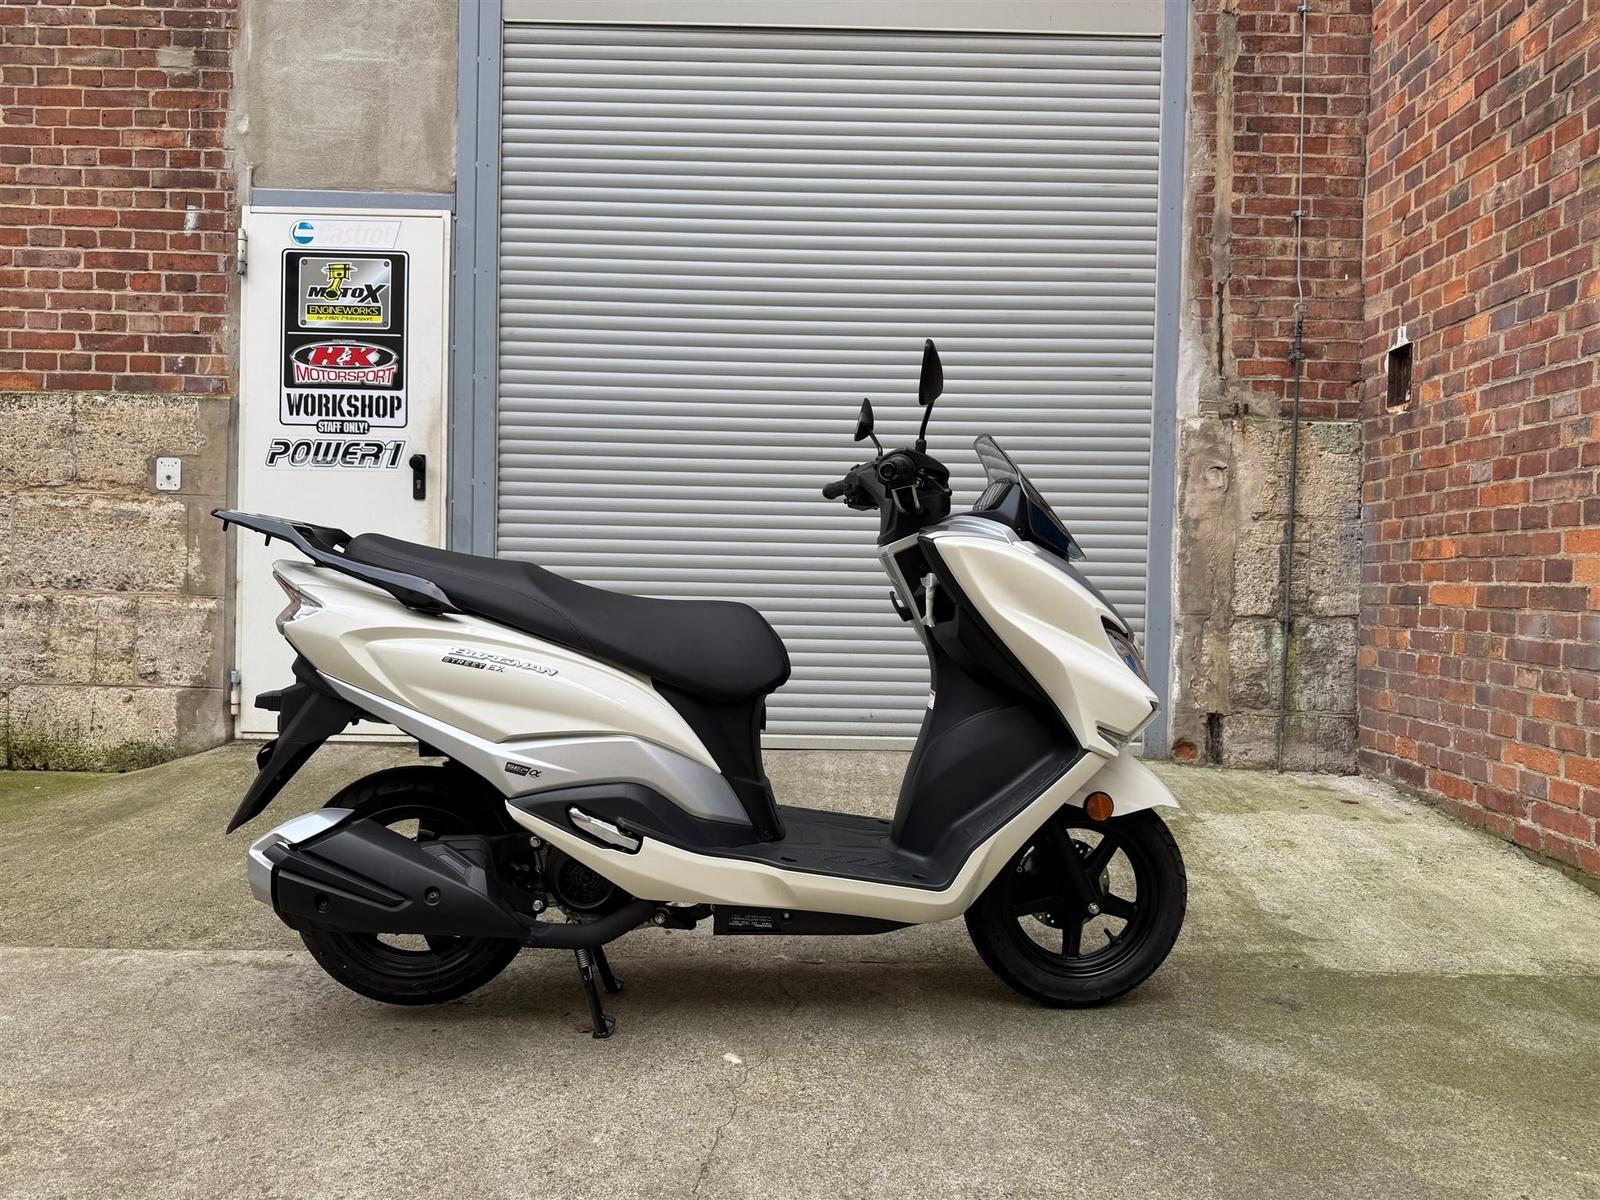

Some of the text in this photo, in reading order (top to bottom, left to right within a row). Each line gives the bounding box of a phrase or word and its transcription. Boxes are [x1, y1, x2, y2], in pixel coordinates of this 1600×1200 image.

[318, 222, 393, 245] Castrol
[309, 306, 379, 315] ENGINEWORKS
[309, 346, 378, 367] H&K
[295, 366, 395, 384] MOTORSPORT
[286, 393, 402, 419] WORKSHOP
[318, 421, 369, 434] STAFF ONLY!
[442, 656, 506, 673] STREET EX
